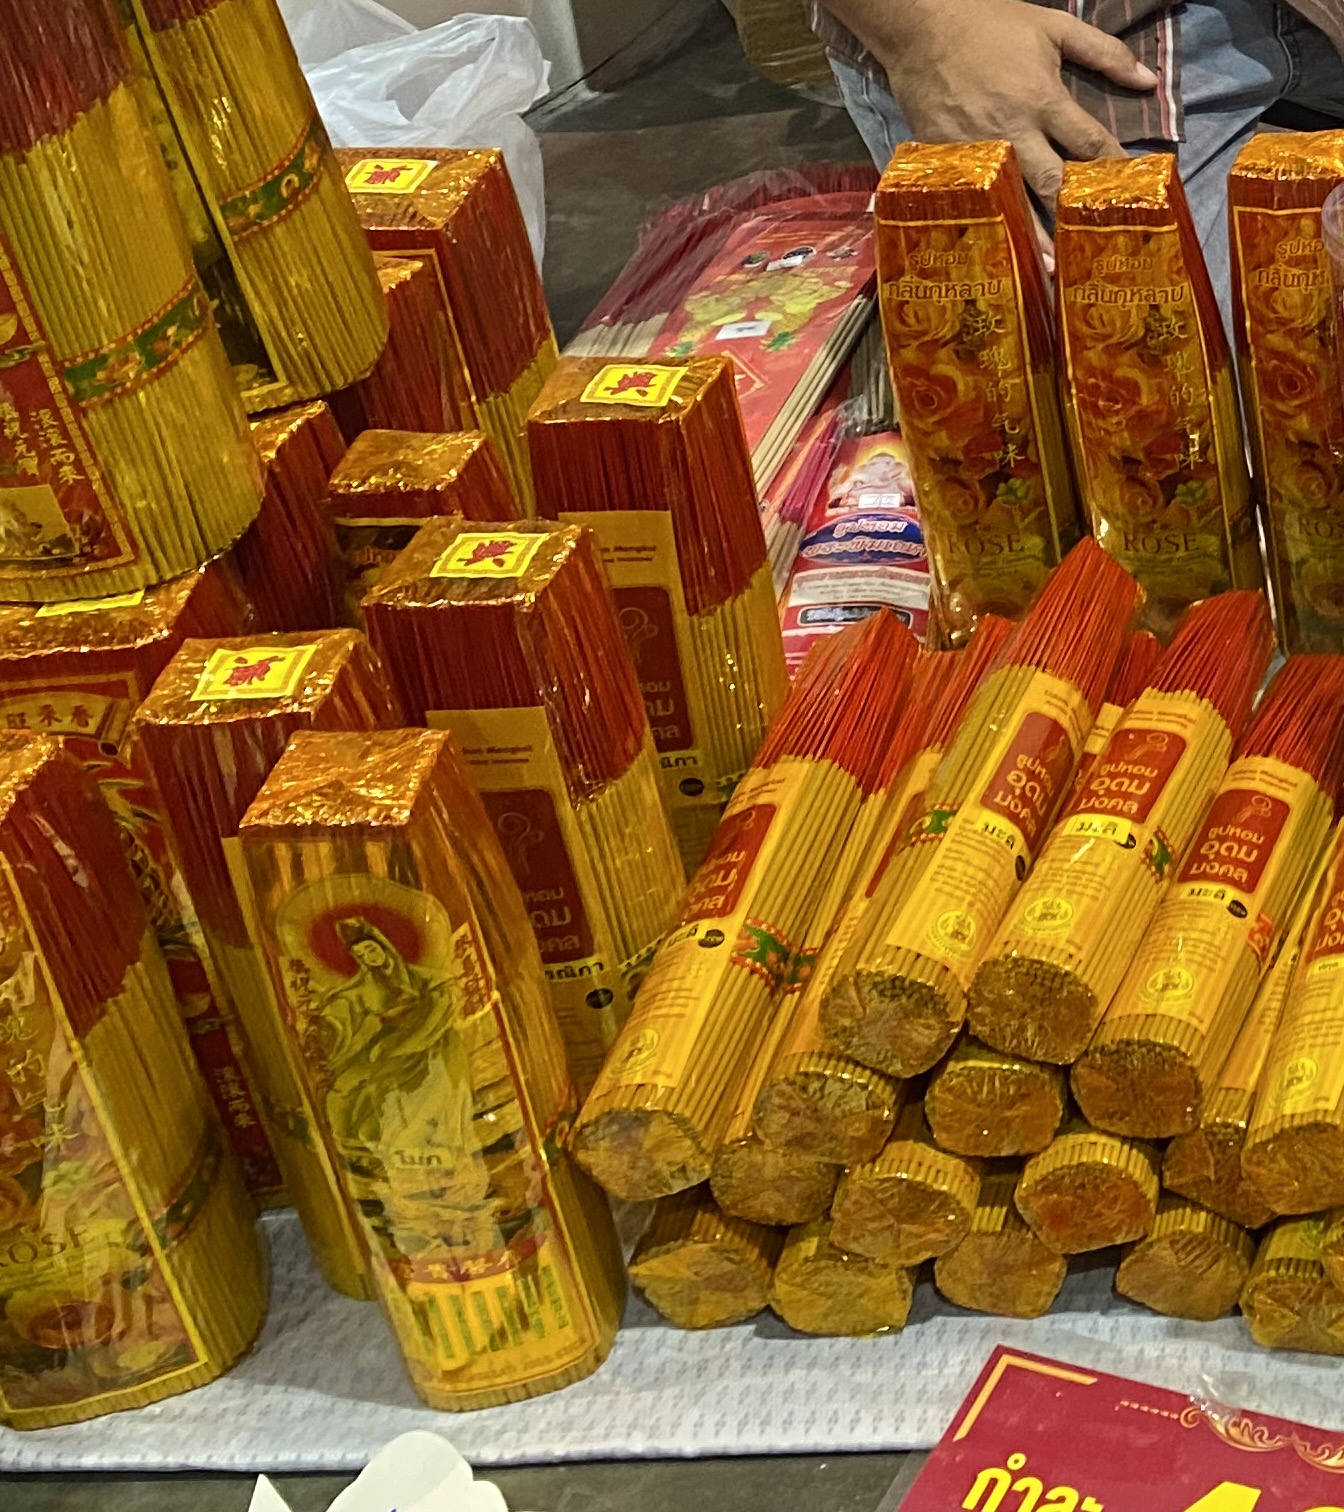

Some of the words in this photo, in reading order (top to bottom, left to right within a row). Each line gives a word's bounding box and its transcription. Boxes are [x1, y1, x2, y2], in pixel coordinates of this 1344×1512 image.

[1277, 238, 1325, 260] ธูปหอ
[886, 276, 1002, 306] กลิ่นกุหลาบ
[1071, 281, 1185, 308] กลิ่นกุหลาบ
[949, 532, 1024, 556] ROSE
[1122, 530, 1200, 556] ROSE
[1099, 760, 1158, 778] ธูปหอม
[1090, 776, 1151, 797] อุดม
[1077, 795, 1140, 815] มงคล
[1207, 824, 1265, 845] ธูปหอม
[1200, 840, 1259, 864] อุดม
[1190, 861, 1249, 884] มงคล
